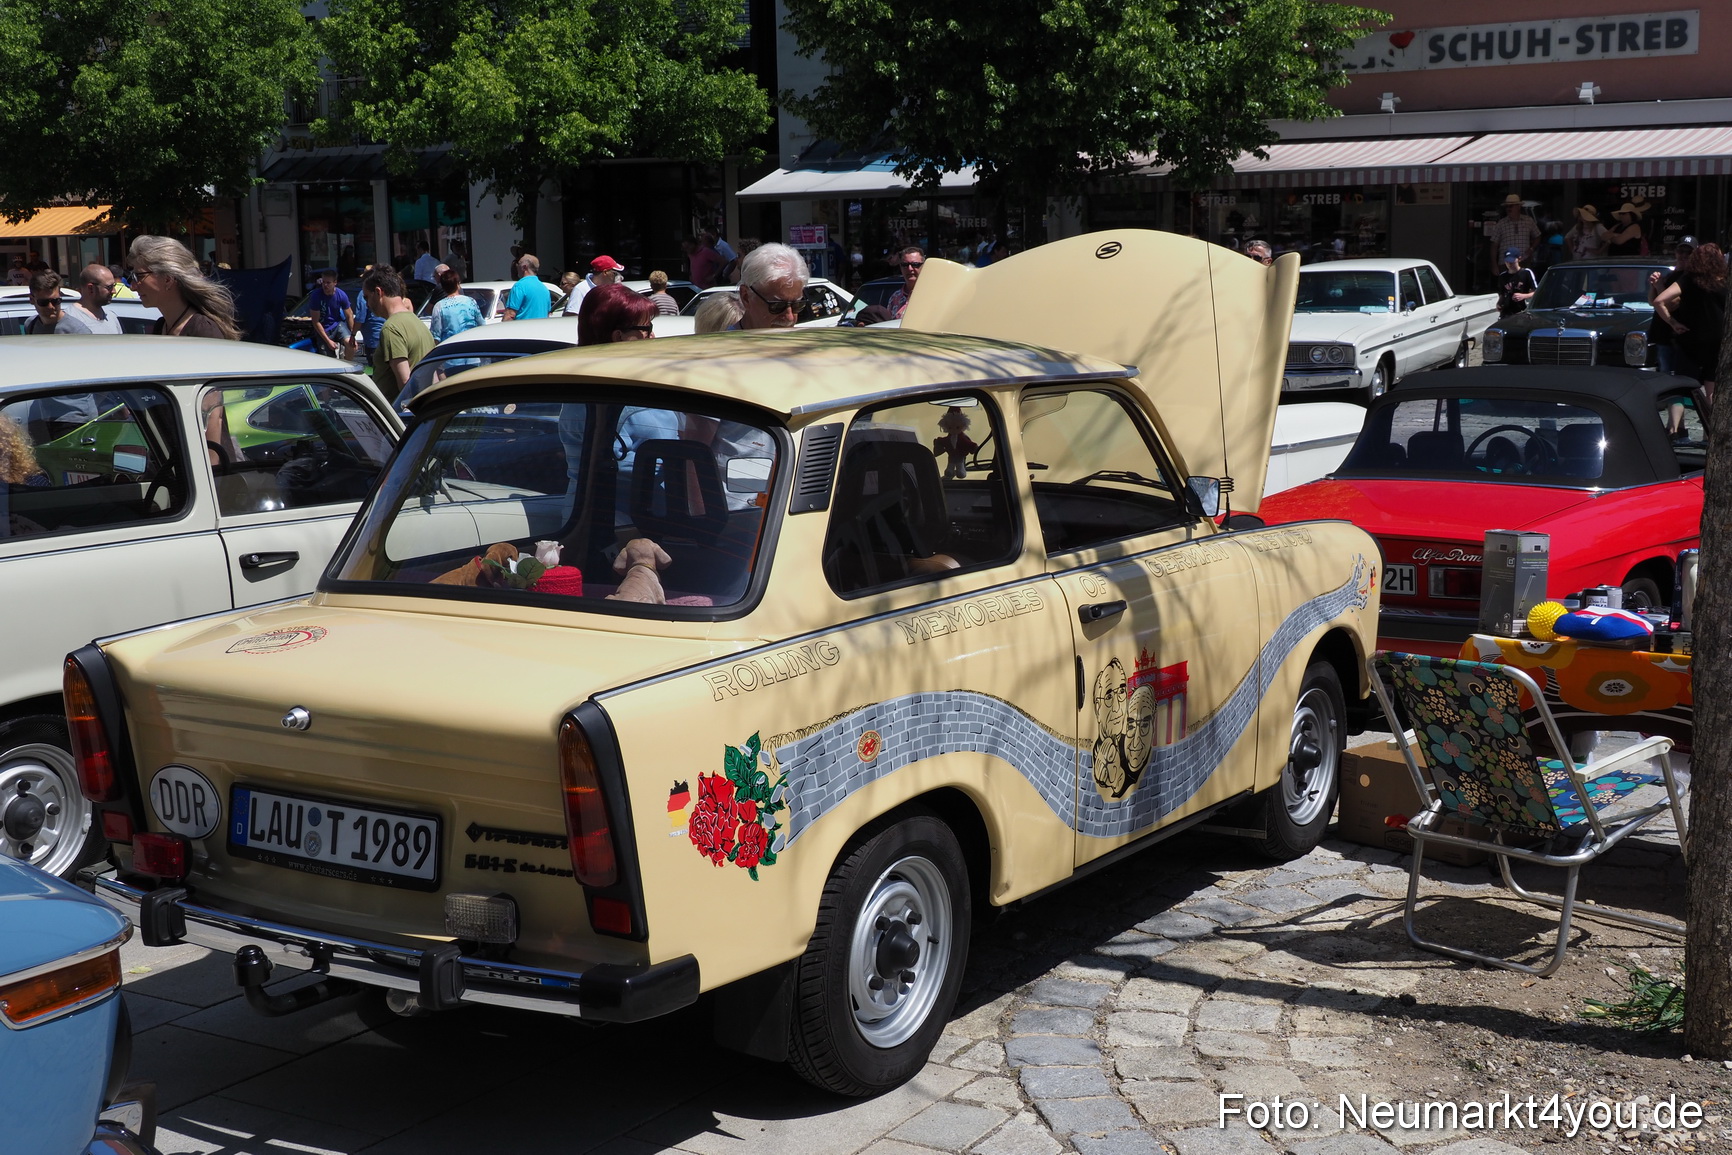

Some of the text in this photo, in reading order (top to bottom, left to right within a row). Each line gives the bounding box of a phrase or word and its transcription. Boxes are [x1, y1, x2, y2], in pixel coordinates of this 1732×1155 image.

[1428, 18, 1688, 64] SCHUH-STREB
[1302, 193, 1341, 205] STREB
[1619, 185, 1666, 198] STREB
[1199, 195, 1237, 207] STREB
[888, 218, 919, 229] STREB
[955, 217, 988, 228] STREB
[1412, 548, 1483, 566] Alfa Rom
[702, 528, 1314, 702] ROLLING MEMORIES OF GERMAN HISTORY
[158, 778, 208, 828] DDR
[236, 797, 432, 870] D LAU T 1989
[288, 861, 358, 881] www.sixstarscars.de
